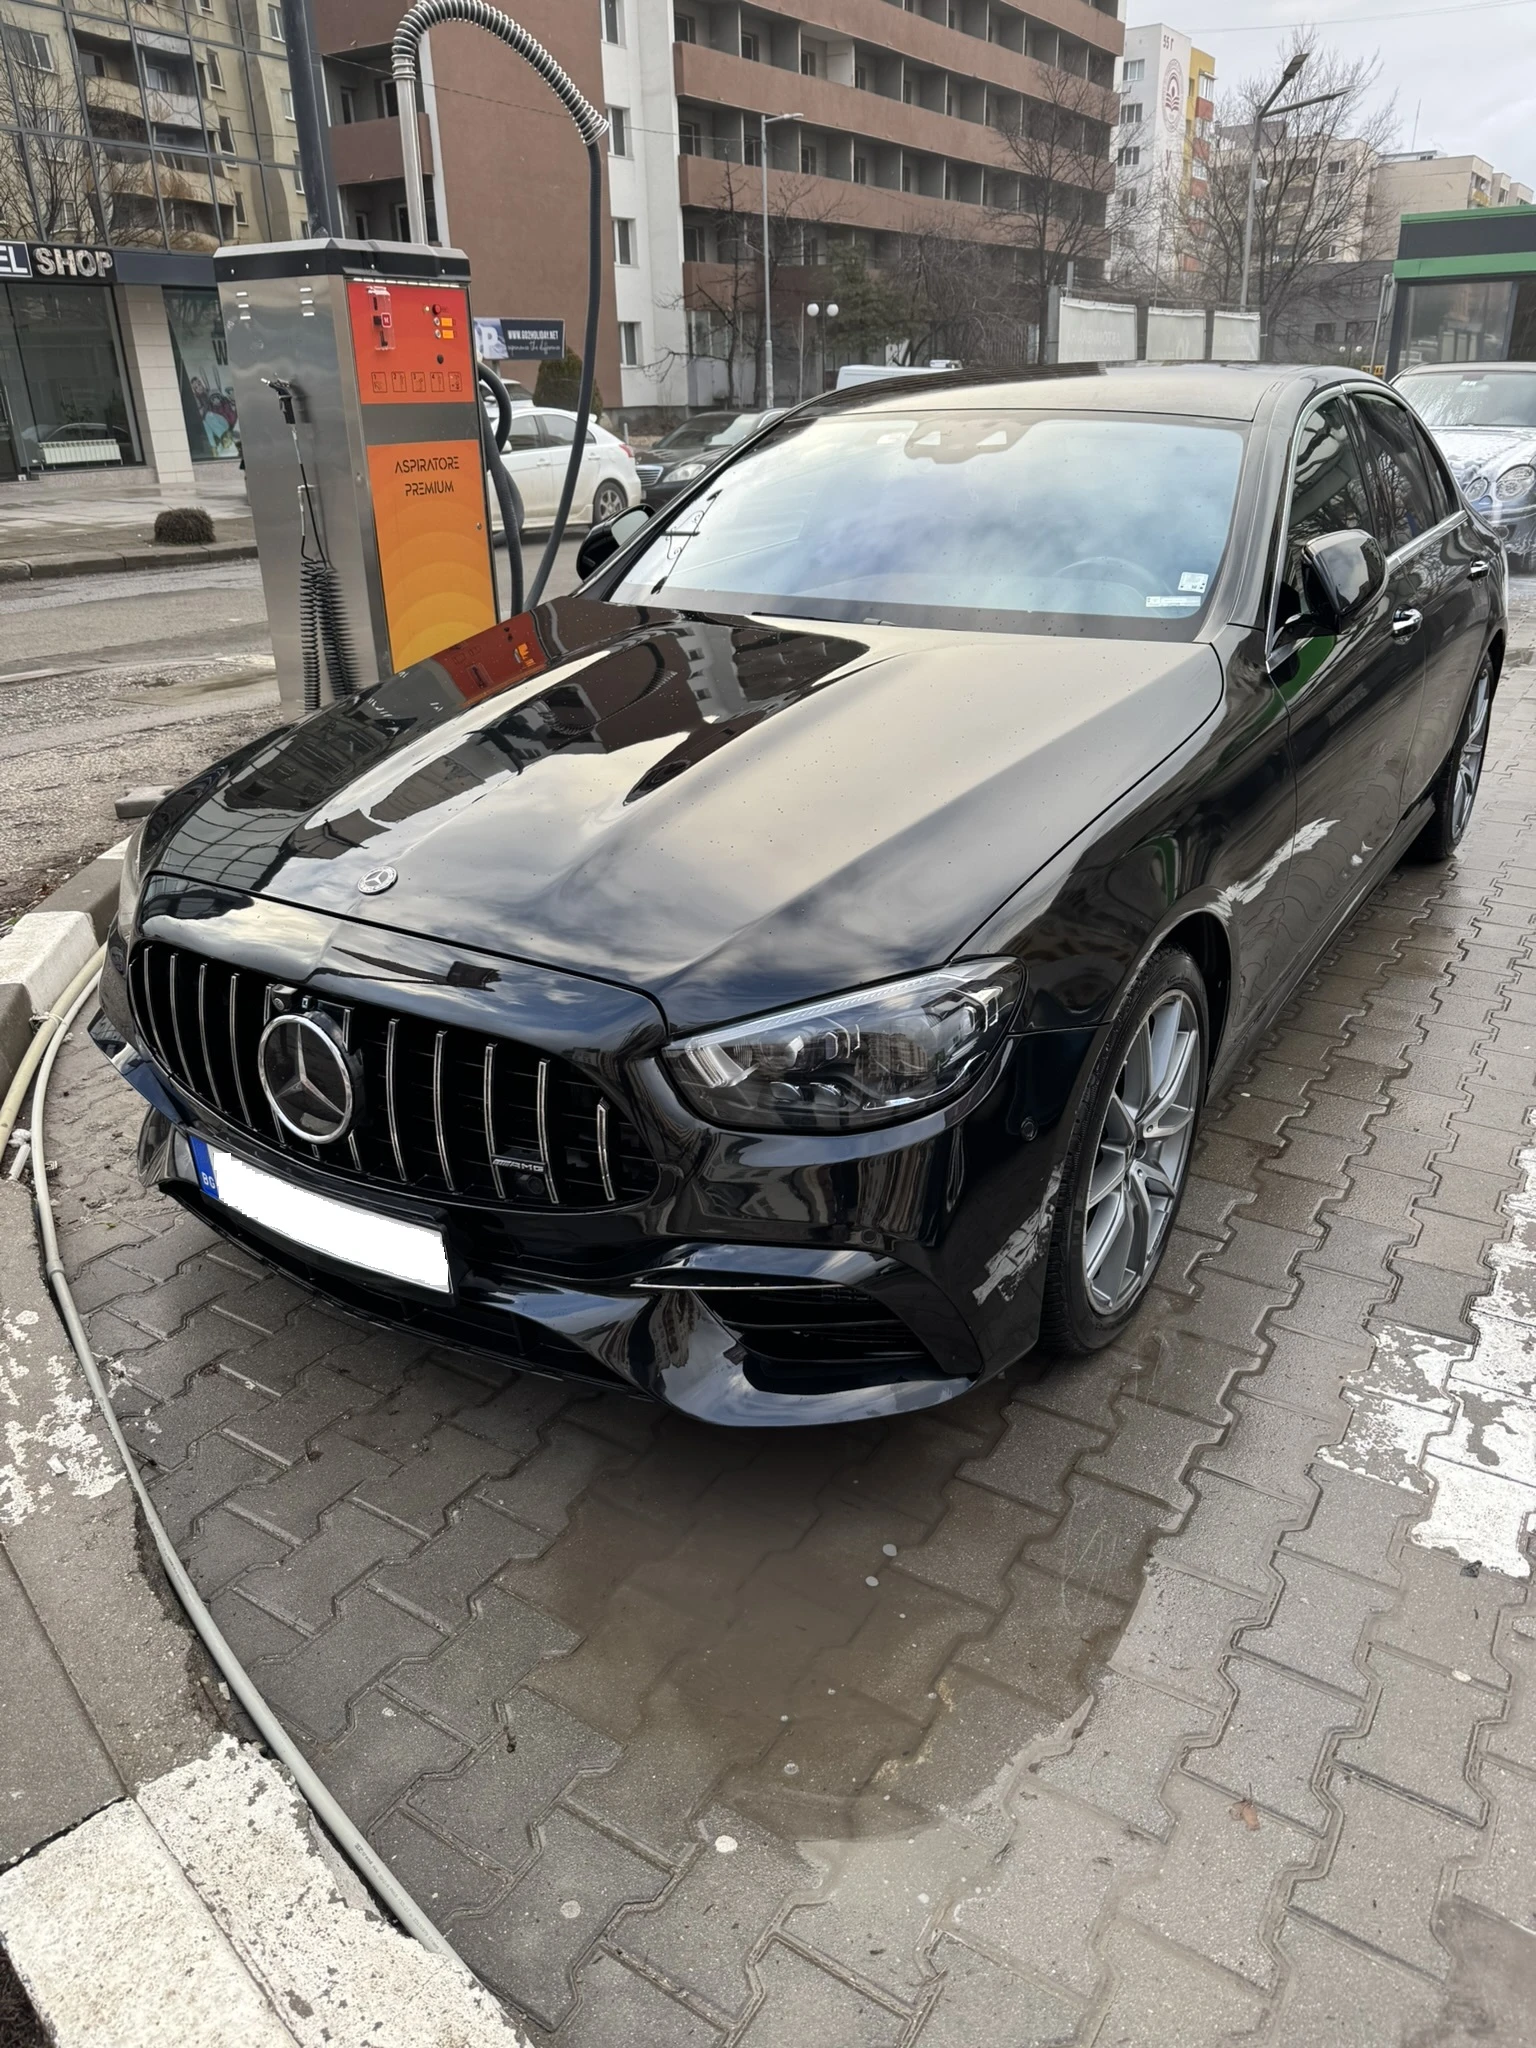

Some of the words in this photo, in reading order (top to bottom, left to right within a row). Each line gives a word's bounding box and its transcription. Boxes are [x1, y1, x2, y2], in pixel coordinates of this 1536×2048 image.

[34, 247, 113, 277] SHOP
[395, 456, 460, 474] ASPIRATORE
[405, 480, 454, 497] PREMIUM
[510, 1161, 544, 1173] AMG
[201, 1171, 216, 1189] BG
